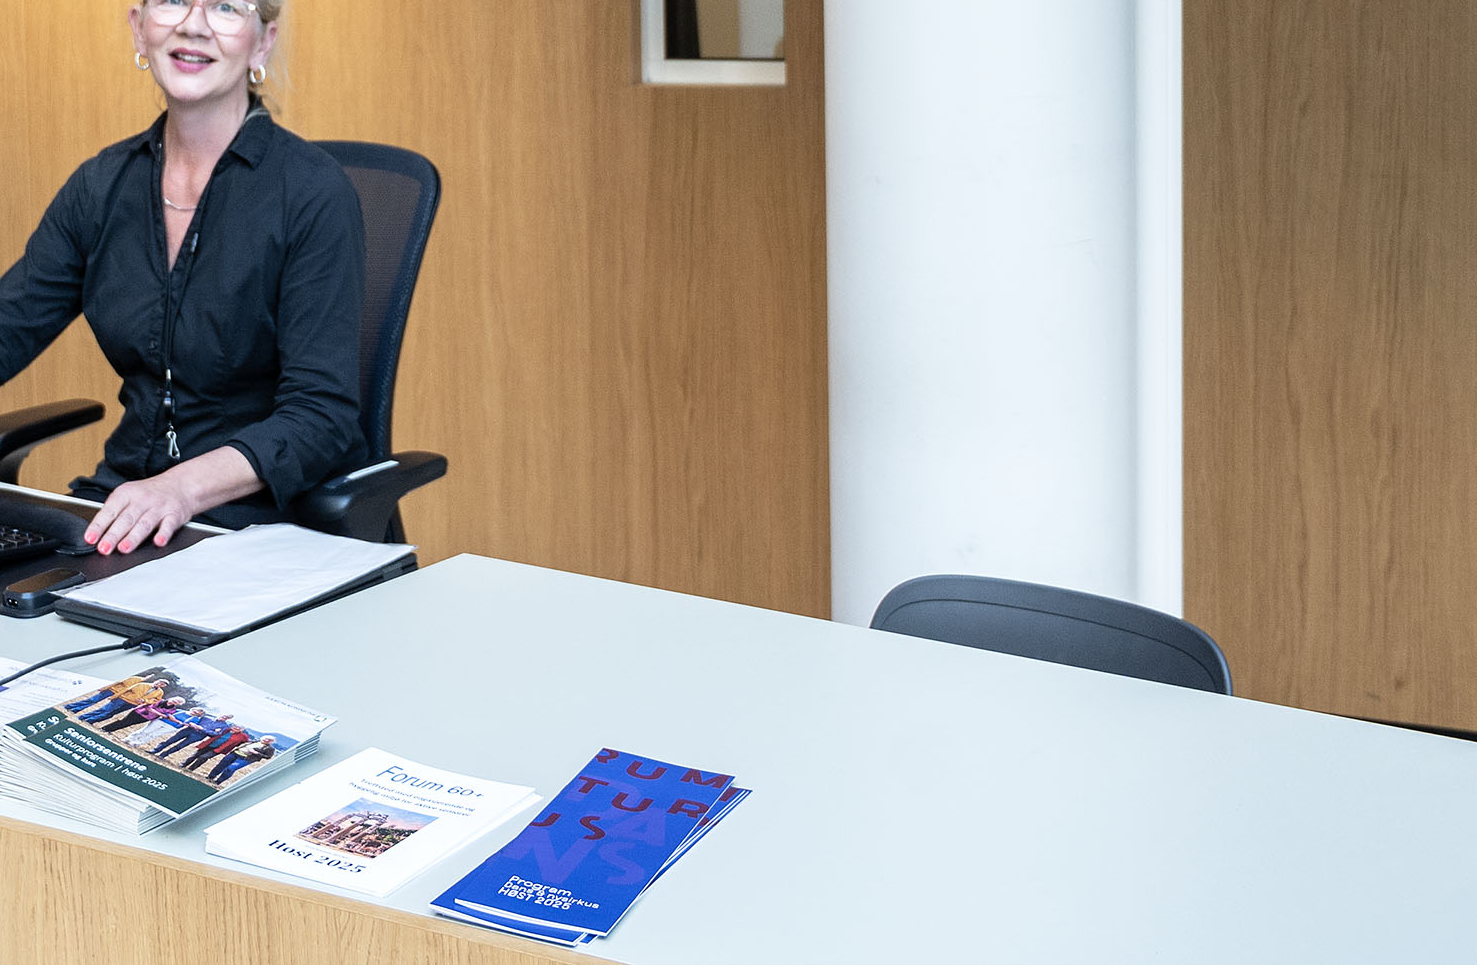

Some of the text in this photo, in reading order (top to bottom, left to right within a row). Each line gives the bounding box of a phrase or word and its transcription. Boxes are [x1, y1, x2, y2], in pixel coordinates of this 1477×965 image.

[63, 726, 148, 772] Seniorsentrene
[52, 733, 116, 769] Kulturprogram
[121, 767, 143, 782] høst
[142, 777, 169, 791] 2025
[375, 765, 484, 798] Forum 60+
[314, 855, 367, 874] 2025
[503, 880, 534, 894] Dans
[509, 874, 572, 897] Program
[497, 886, 572, 911] HØST 2025
